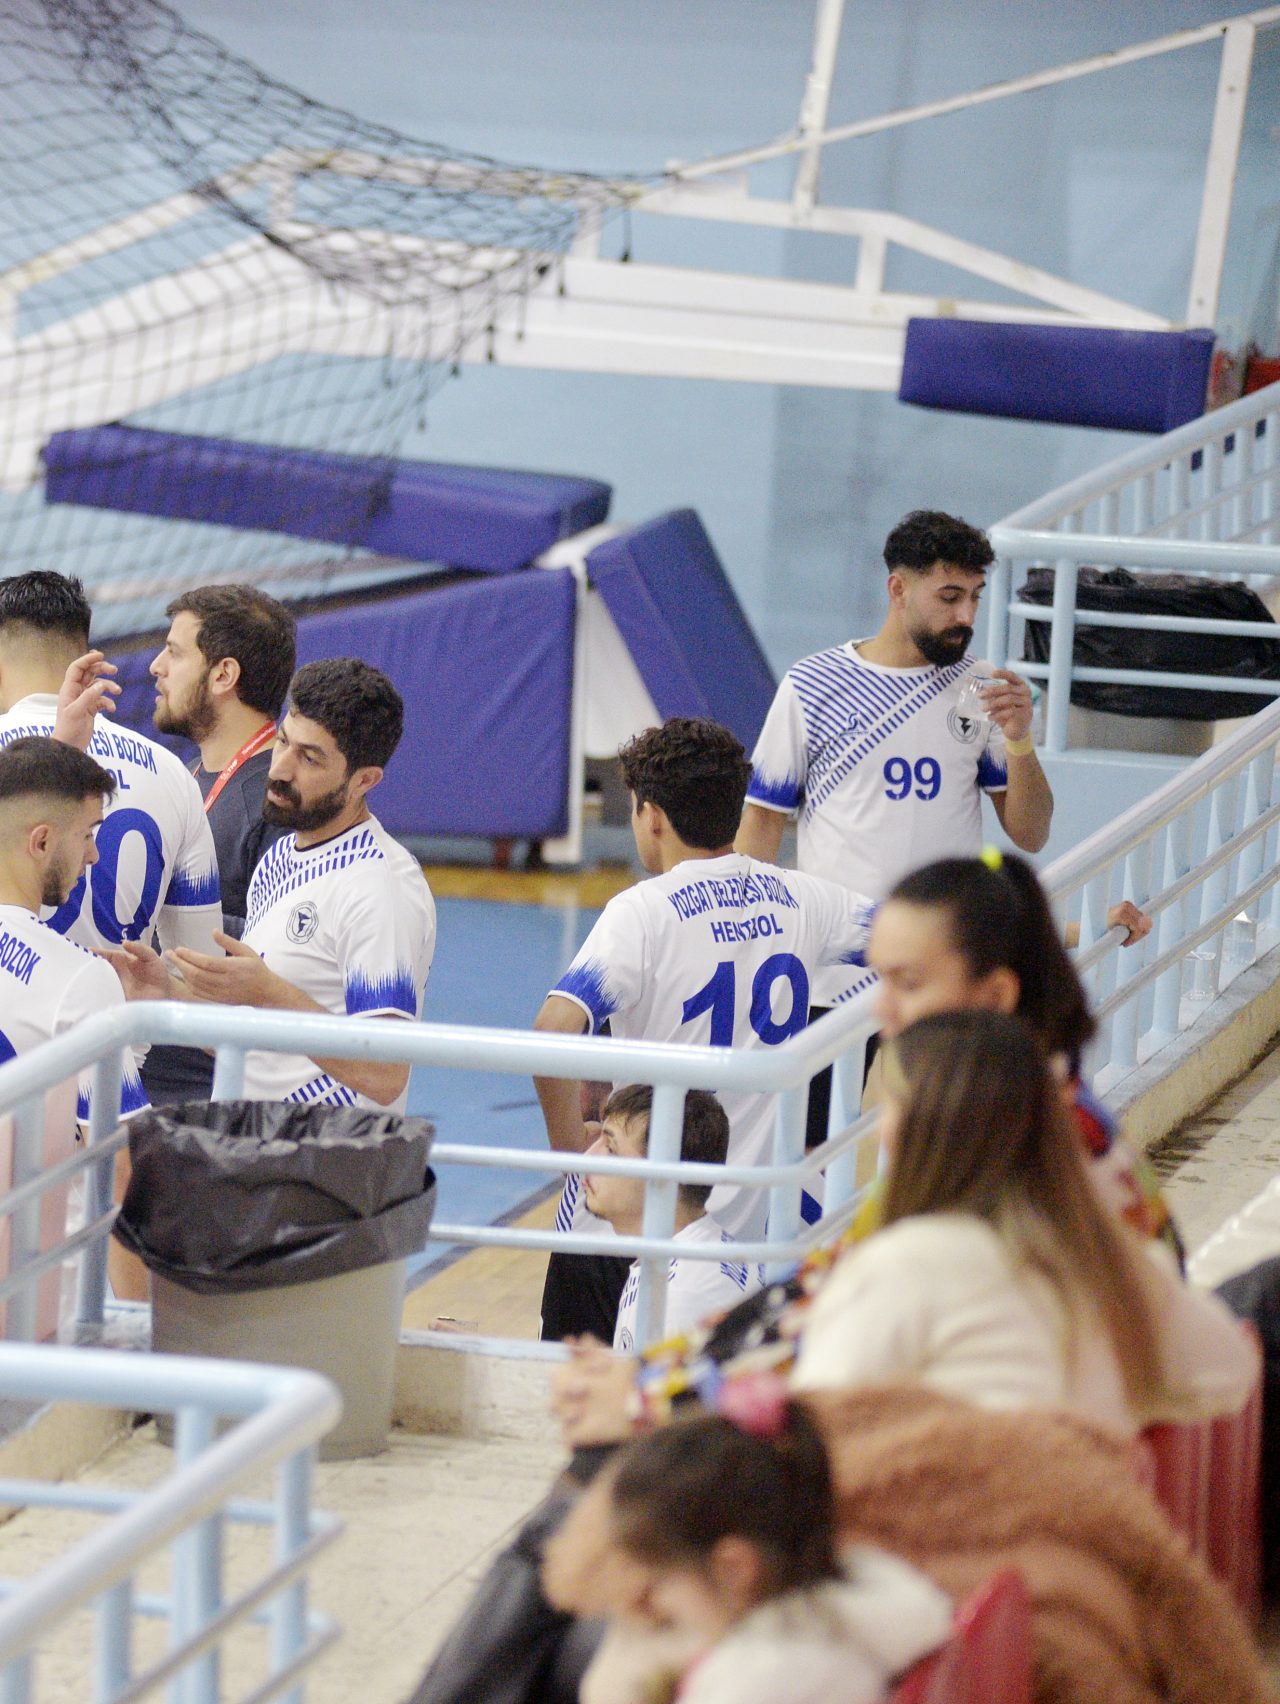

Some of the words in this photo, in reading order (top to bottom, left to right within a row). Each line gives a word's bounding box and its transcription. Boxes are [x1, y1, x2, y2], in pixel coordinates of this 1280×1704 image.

[111, 733, 157, 775] BOZOK
[883, 757, 942, 801] 99
[668, 880, 713, 922] YOZGAT
[710, 913, 783, 943] HENTBOL
